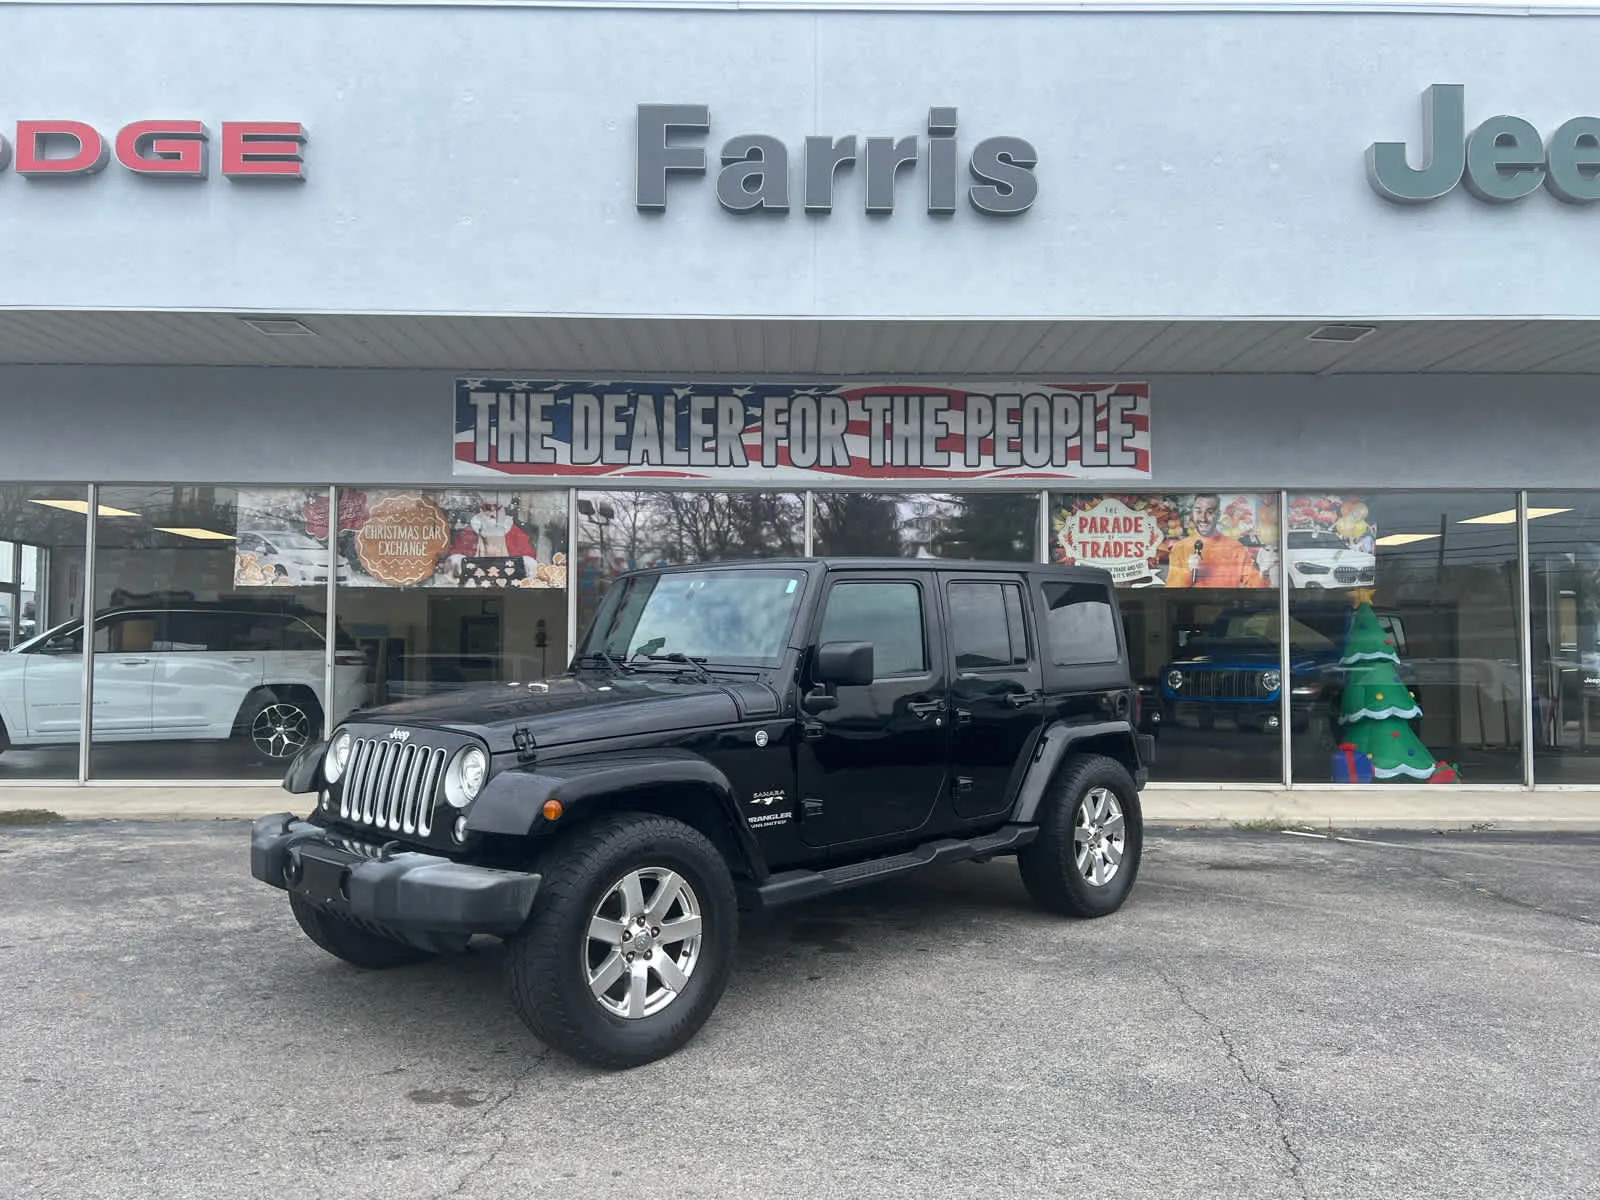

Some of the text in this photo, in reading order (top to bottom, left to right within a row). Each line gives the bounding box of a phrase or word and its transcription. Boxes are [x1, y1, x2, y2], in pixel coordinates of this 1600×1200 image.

[0, 119, 306, 181] DGE
[636, 104, 1039, 214] Farris
[469, 391, 1137, 468] THE DEALER FOR THE PEOPLE
[364, 524, 442, 540] CHRISTMAS CAR
[1078, 516, 1144, 533] PARADE
[378, 541, 429, 556] EXCHANGE
[1078, 541, 1145, 558] TRADES
[389, 727, 410, 742] Jeep
[748, 812, 792, 823] WRANGLER
